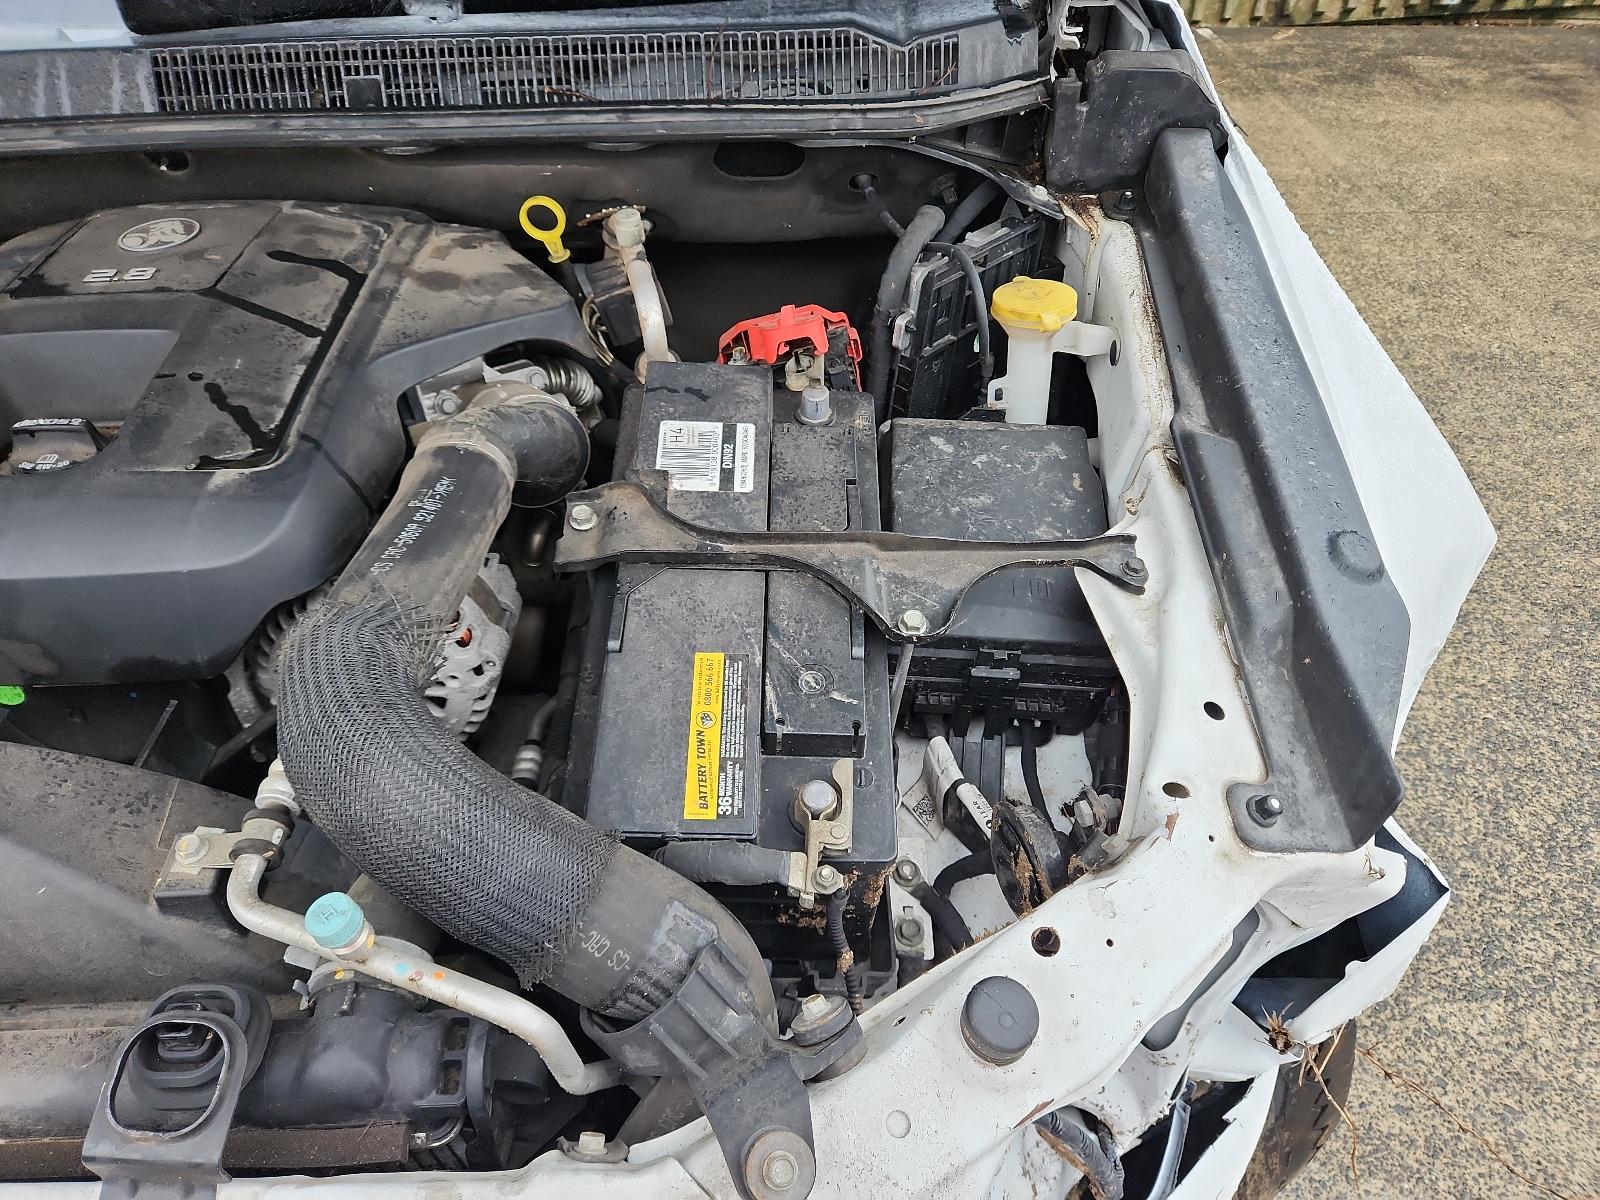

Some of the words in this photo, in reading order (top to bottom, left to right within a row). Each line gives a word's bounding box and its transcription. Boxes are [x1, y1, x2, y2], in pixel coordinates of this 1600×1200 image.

[82, 267, 157, 282] 2.8
[669, 427, 684, 443] H4
[722, 443, 734, 469] DIN92
[706, 658, 714, 671] 667
[704, 672, 713, 687] 566
[704, 688, 713, 706] 0800
[695, 729, 706, 759] TOWN
[697, 763, 709, 810] BATTERY
[725, 760, 733, 796] WARRANTY
[718, 796, 732, 816] 36
